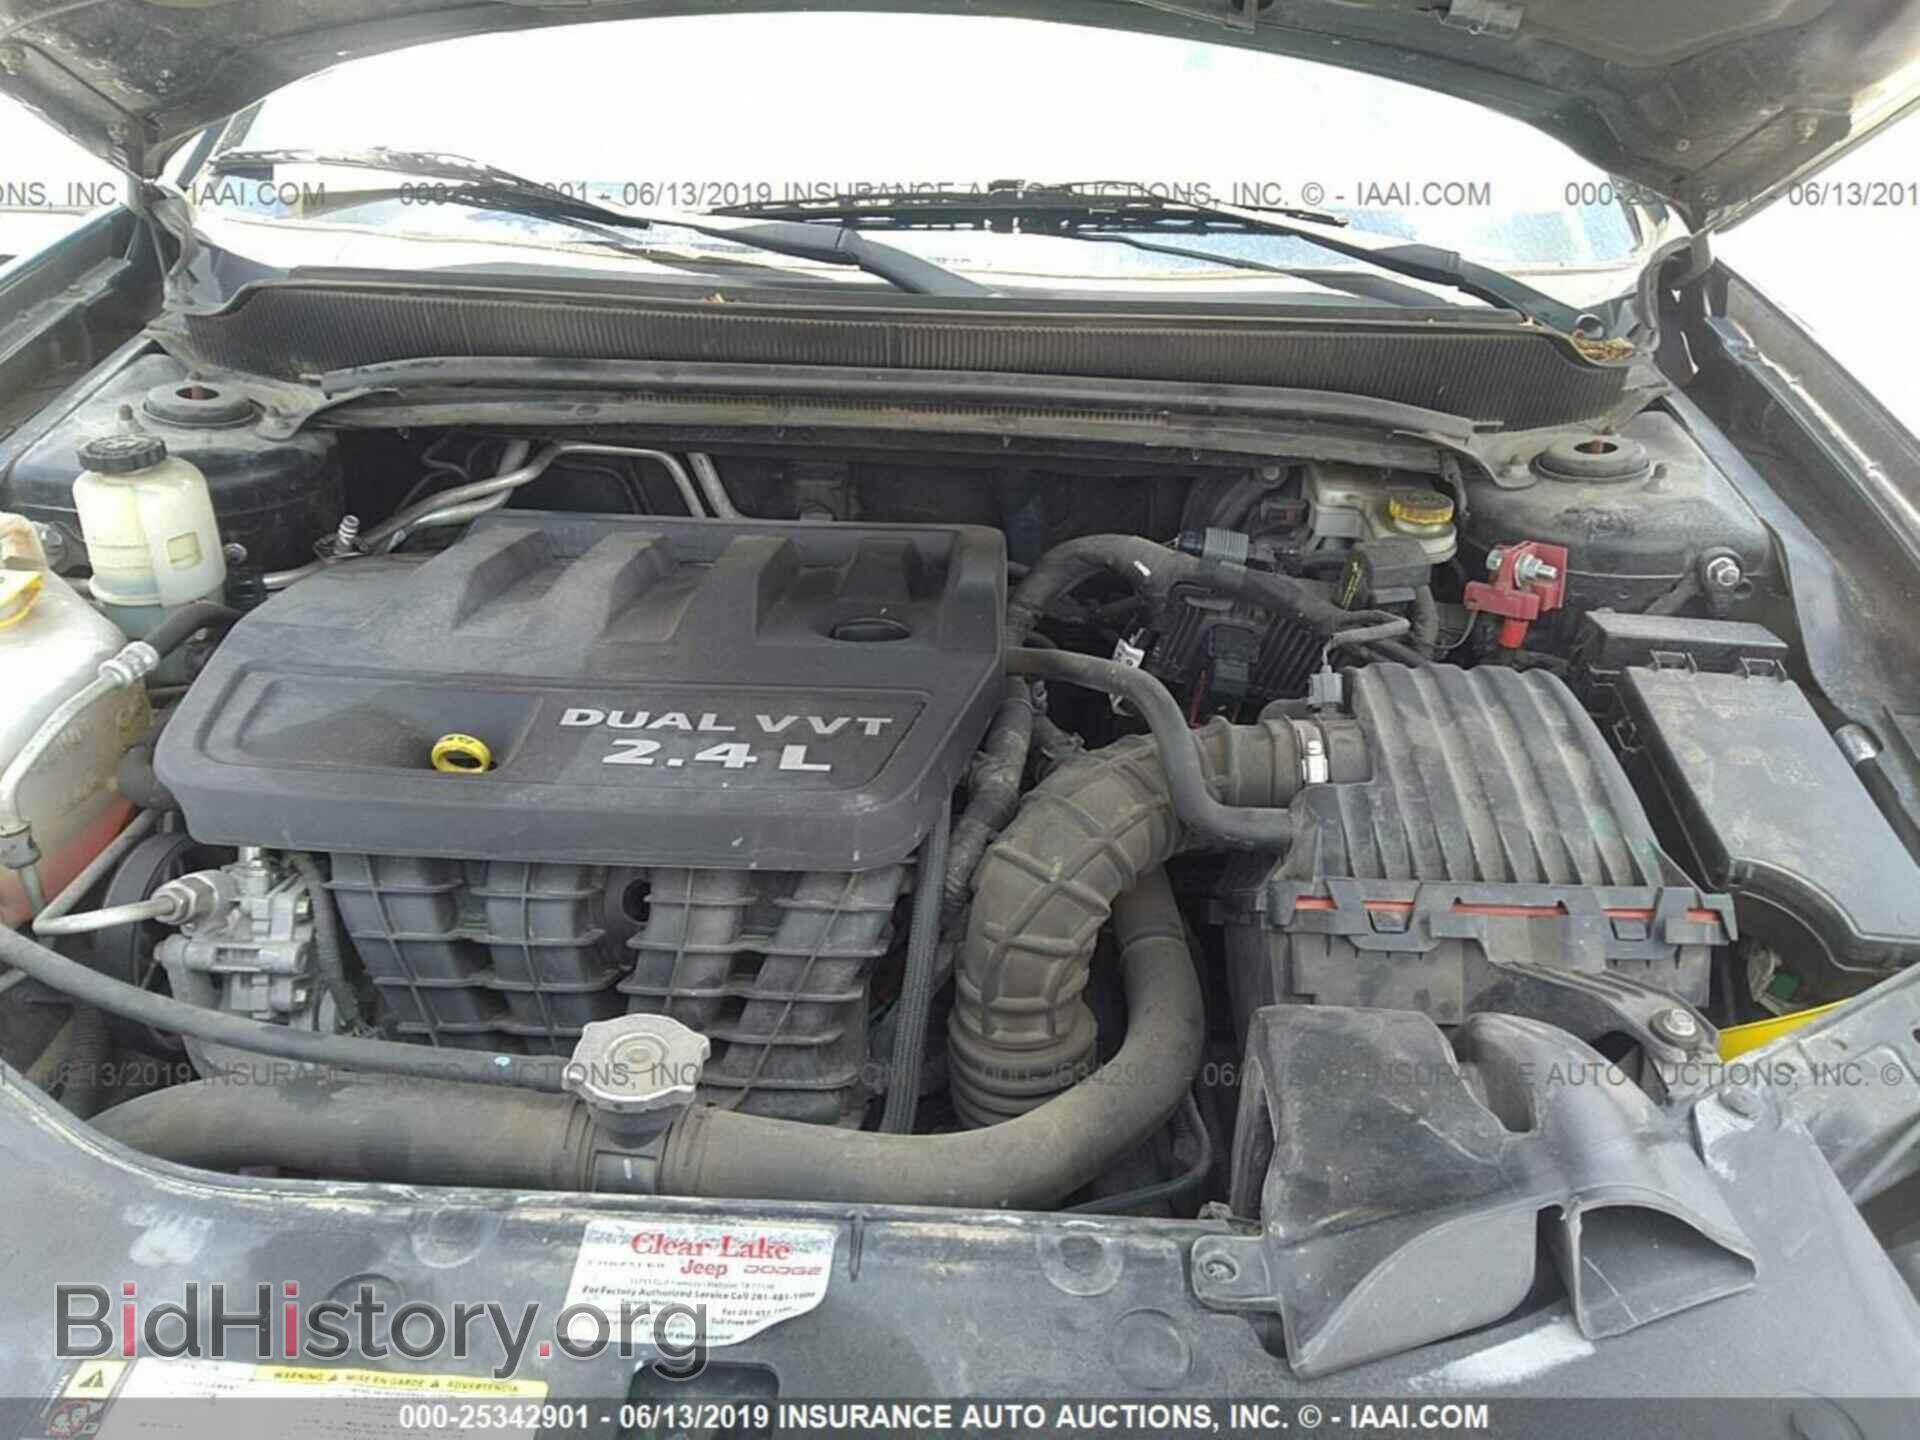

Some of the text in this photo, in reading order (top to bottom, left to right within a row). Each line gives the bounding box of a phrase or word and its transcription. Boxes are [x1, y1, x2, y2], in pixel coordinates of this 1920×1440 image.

[560, 709, 893, 736] DUAL VVT
[602, 739, 832, 771] 2.4L
[630, 1232, 794, 1261] Clear Lake
[680, 1260, 728, 1279] Jeep
